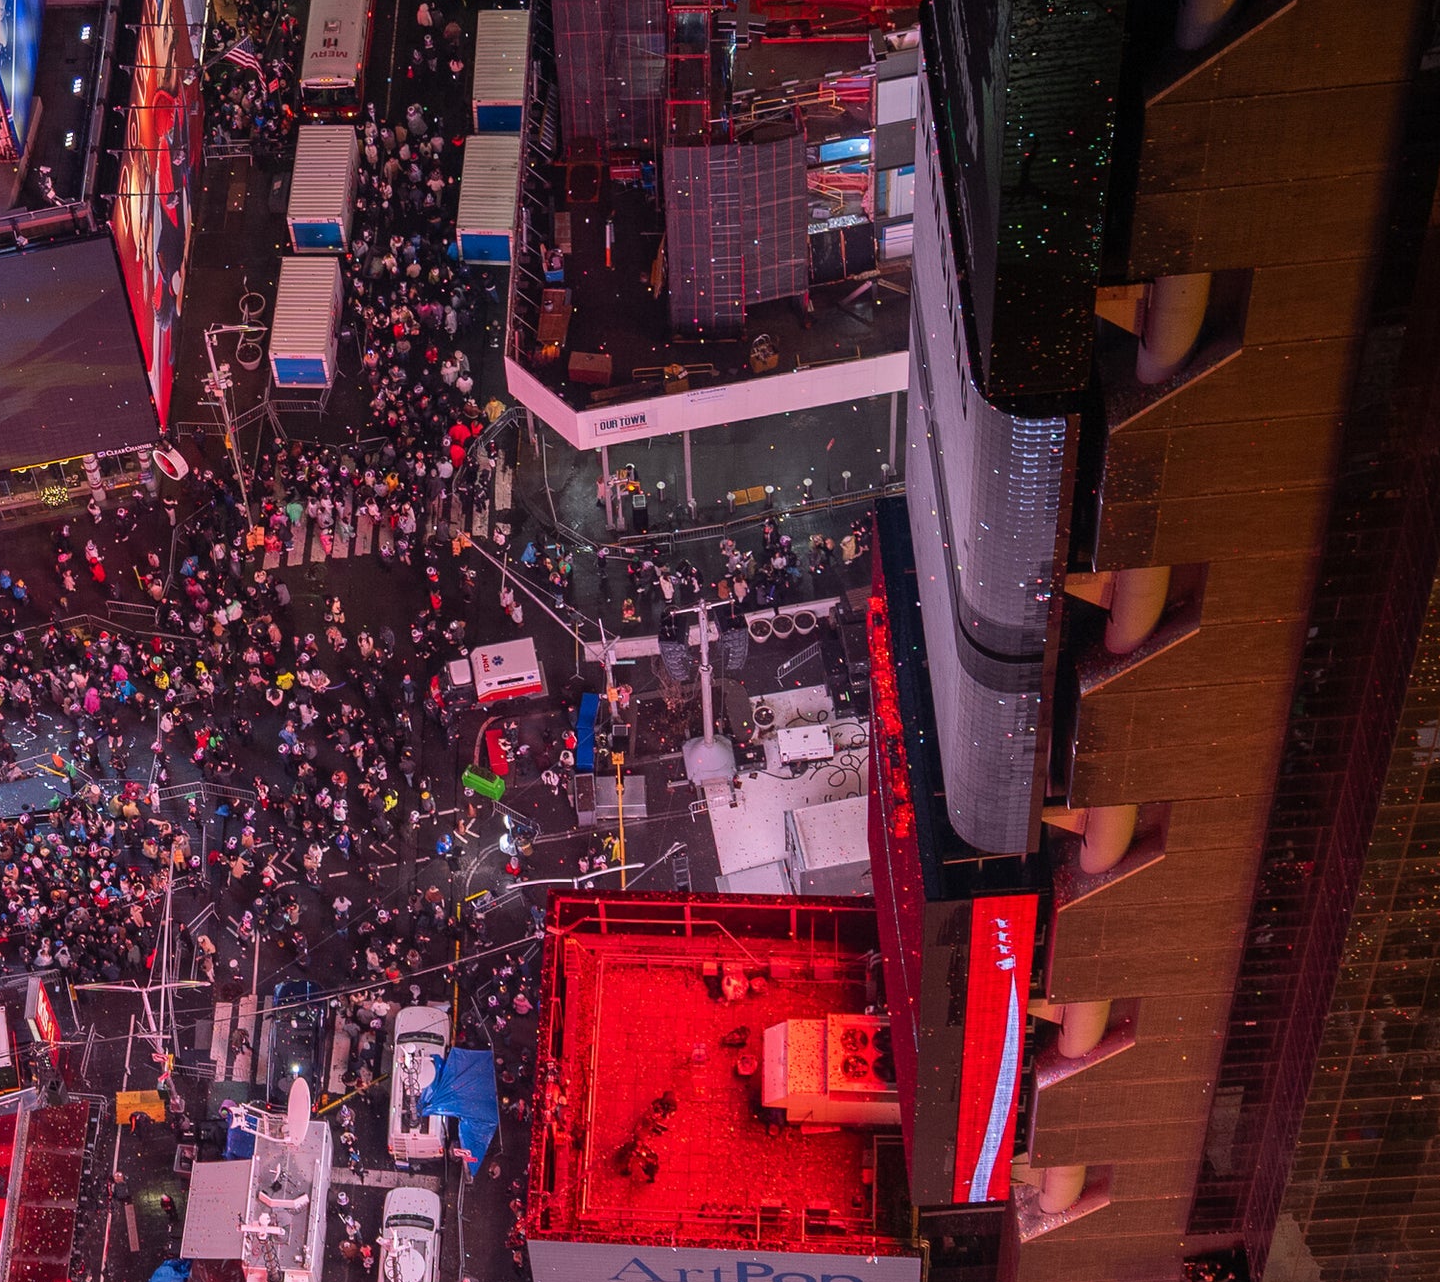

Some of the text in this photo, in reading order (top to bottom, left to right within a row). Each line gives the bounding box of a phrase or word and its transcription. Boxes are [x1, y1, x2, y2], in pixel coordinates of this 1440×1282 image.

[600, 413, 647, 431] OUR TOWN
[106, 442, 153, 458] CLEAR CHANNEL
[483, 653, 491, 673] FDNY
